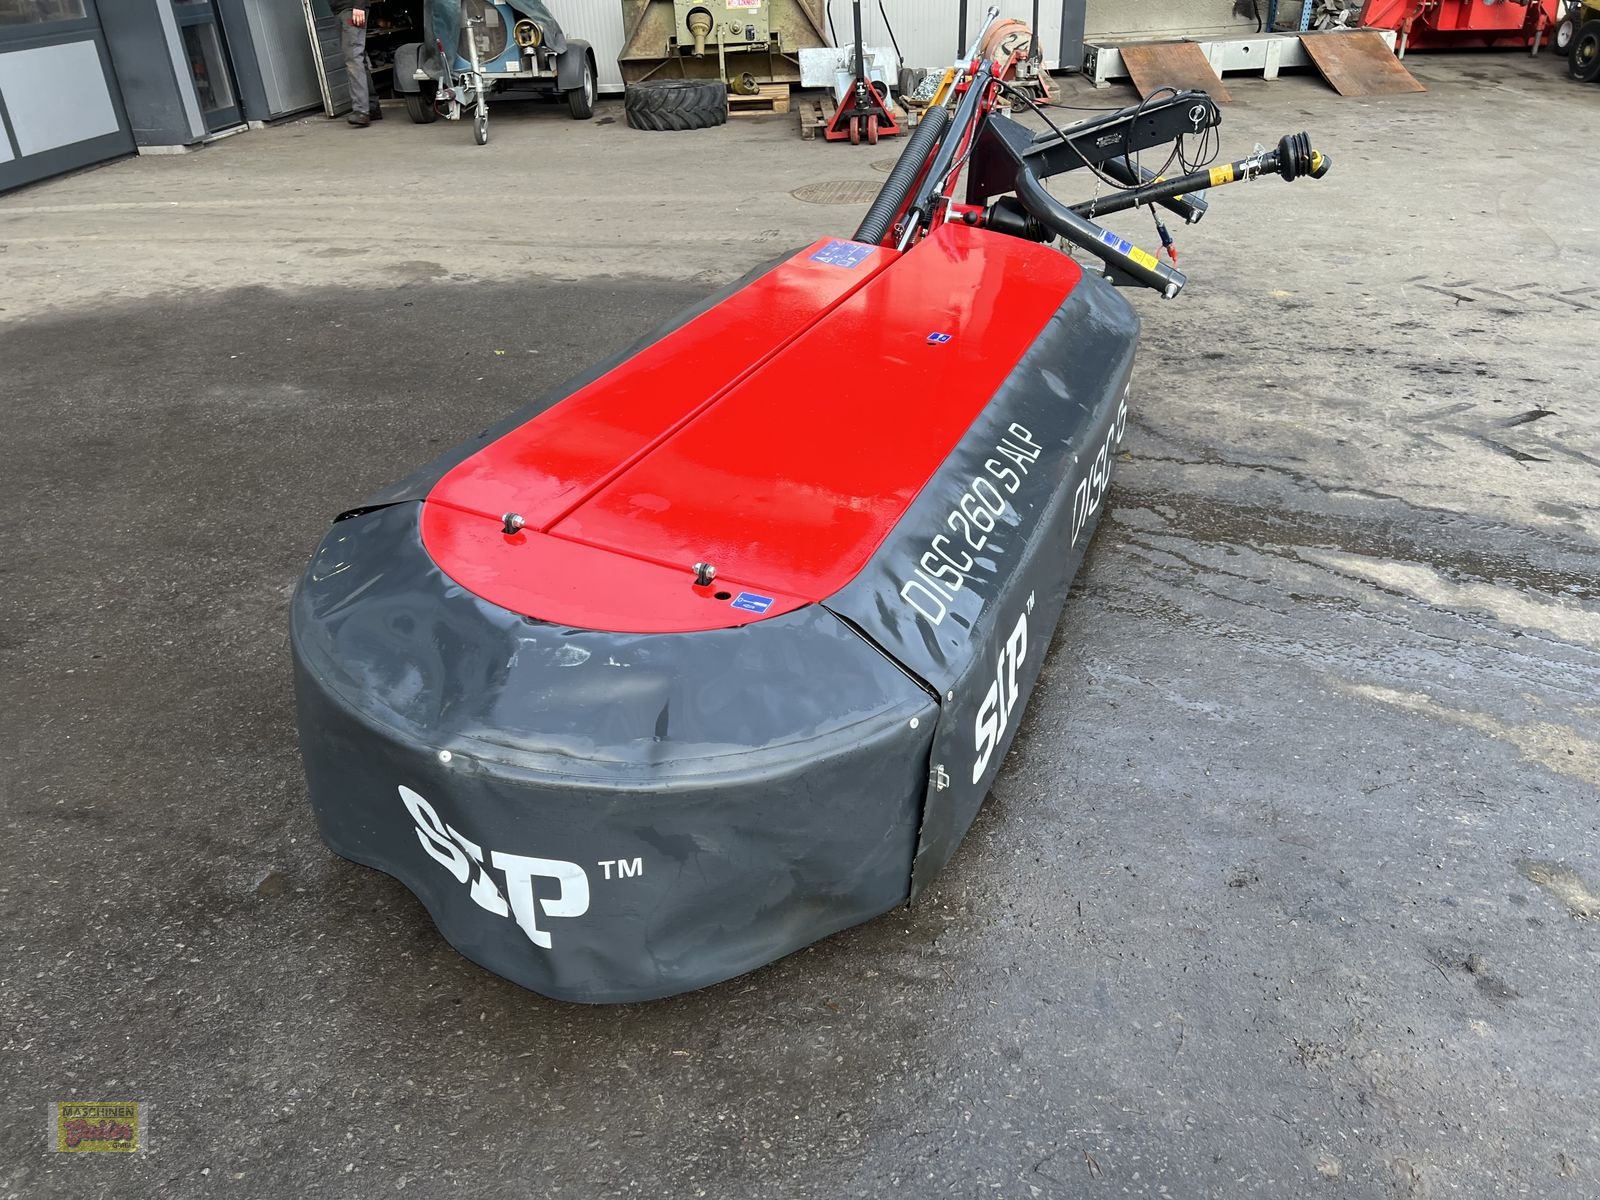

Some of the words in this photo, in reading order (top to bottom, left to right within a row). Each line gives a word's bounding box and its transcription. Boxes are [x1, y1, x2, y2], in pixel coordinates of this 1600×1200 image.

[984, 460, 1022, 493] S
[996, 422, 1044, 475] ALP
[1071, 423, 1115, 551] DISC
[947, 475, 1005, 552] 260
[901, 534, 974, 627] DISC
[973, 612, 1029, 785] SIP
[397, 785, 590, 950] SIP
